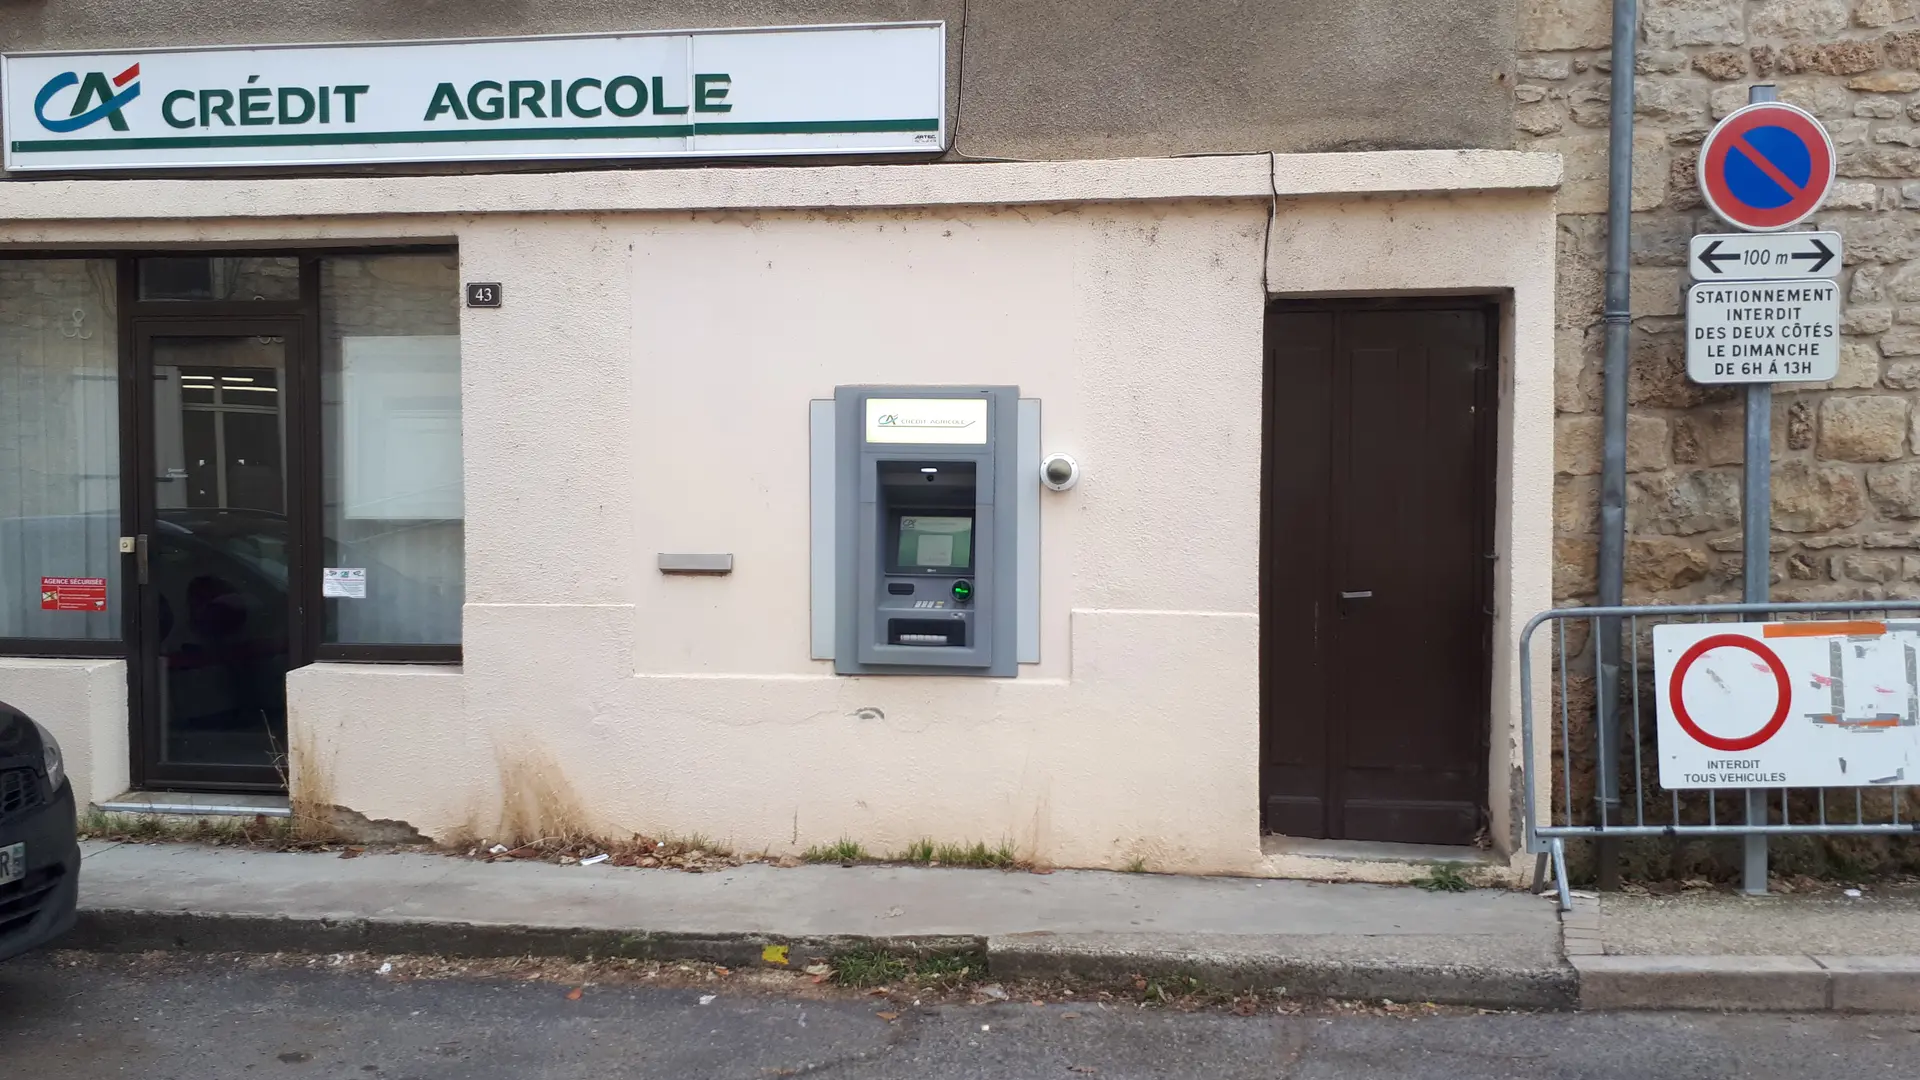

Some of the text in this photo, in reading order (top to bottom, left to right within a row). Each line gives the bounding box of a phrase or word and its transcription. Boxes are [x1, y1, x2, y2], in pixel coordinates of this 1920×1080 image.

[161, 75, 370, 129] CRÉDIT
[423, 73, 733, 122] AGRICOLE
[1743, 249, 1789, 265] 100 m
[475, 288, 492, 302] 43
[1695, 288, 1833, 303] STATIONNEMENT
[1726, 307, 1802, 321] INTERDIT
[1694, 322, 1833, 340] DES DEUX CÔTÉS
[1707, 343, 1820, 358] LE DIMANCHE
[1714, 362, 1735, 375] DE
[1741, 361, 1763, 375] 6H
[1784, 361, 1812, 374] 13H
[1707, 759, 1761, 770] INTERDIT
[1684, 772, 1787, 783] TOUS VEHICULES
